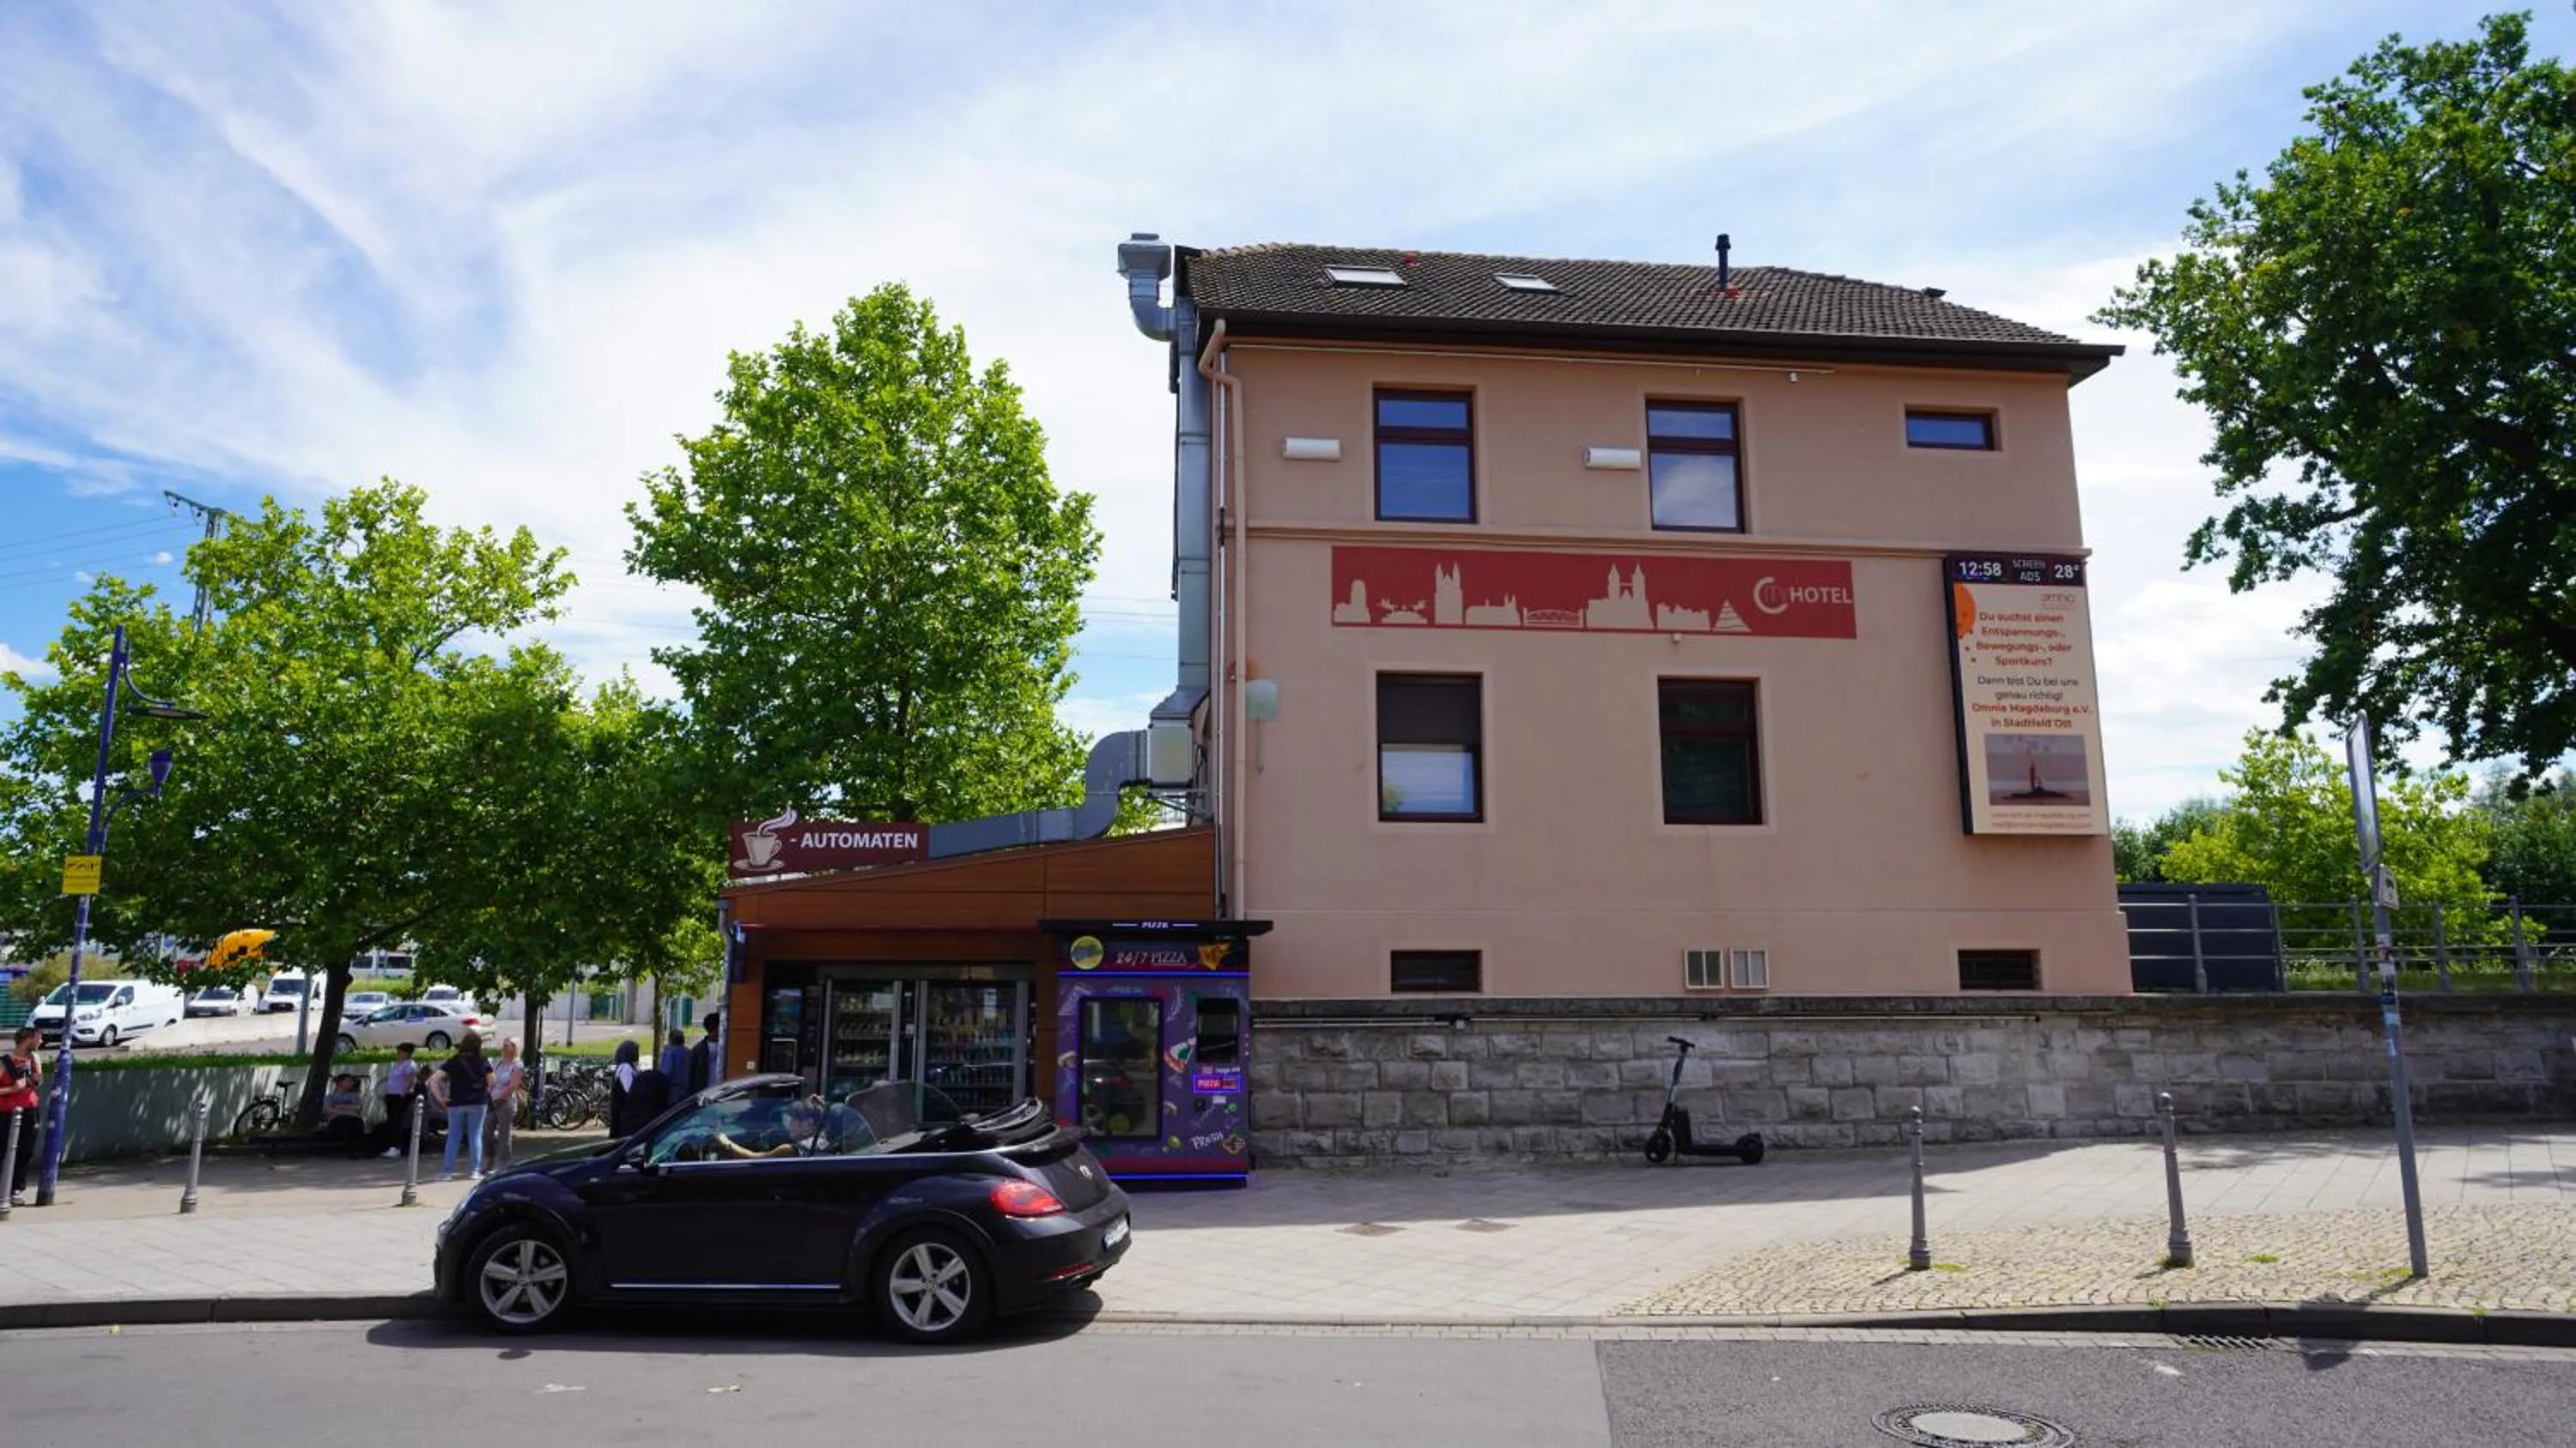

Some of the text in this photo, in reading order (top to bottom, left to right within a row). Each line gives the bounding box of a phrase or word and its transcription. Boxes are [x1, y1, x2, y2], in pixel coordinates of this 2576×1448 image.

[1959, 561, 2002, 576] 12:58
[2013, 559, 2046, 569] SCREEN
[2020, 571, 2041, 581] ADS
[1790, 586, 1853, 604] HOTEL
[1978, 611, 1995, 621] Du
[2034, 613, 2064, 623] einen
[2048, 642, 2072, 652] oder
[1995, 656, 2053, 667] Sportkurs?
[1978, 676, 2005, 685] Dann
[2026, 677, 2041, 686] Du
[2043, 676, 2059, 686] bei
[2060, 678, 2079, 686] uns
[1995, 691, 2026, 701] genau
[2009, 703, 2070, 715] Magdeburg
[1990, 718, 2002, 727] in
[2003, 718, 2052, 728] Stadtfeld
[1116, 950, 1187, 967] 24/7 PIZZA
